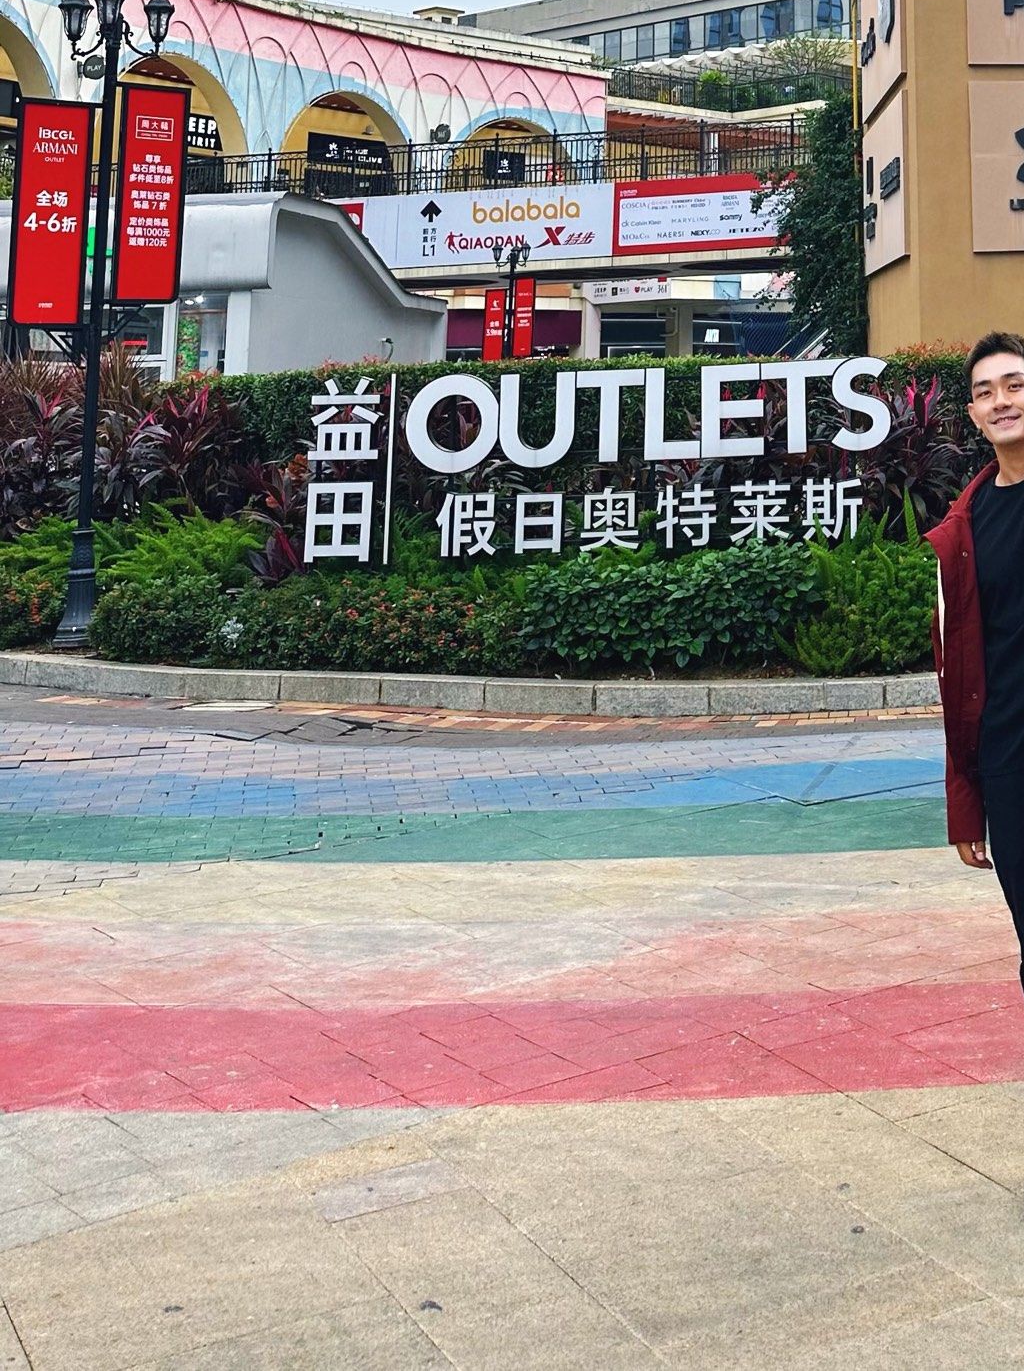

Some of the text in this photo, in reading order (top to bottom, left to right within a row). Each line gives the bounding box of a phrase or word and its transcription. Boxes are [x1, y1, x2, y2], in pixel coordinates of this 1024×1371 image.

[87, 64, 102, 72] PLAY
[188, 116, 217, 135] EEP.
[33, 142, 78, 155] ARMANI
[187, 135, 216, 149] IRIT
[36, 190, 68, 208] 全场
[472, 196, 581, 224] balabala
[23, 212, 77, 233] 4-6折
[458, 233, 525, 250] QIAODAN
[656, 231, 685, 239] NAERSI
[422, 244, 436, 257] L1
[405, 356, 892, 474] OUTLETS
[303, 376, 385, 564] 益田
[435, 477, 865, 559] 假日奥特莱斯
